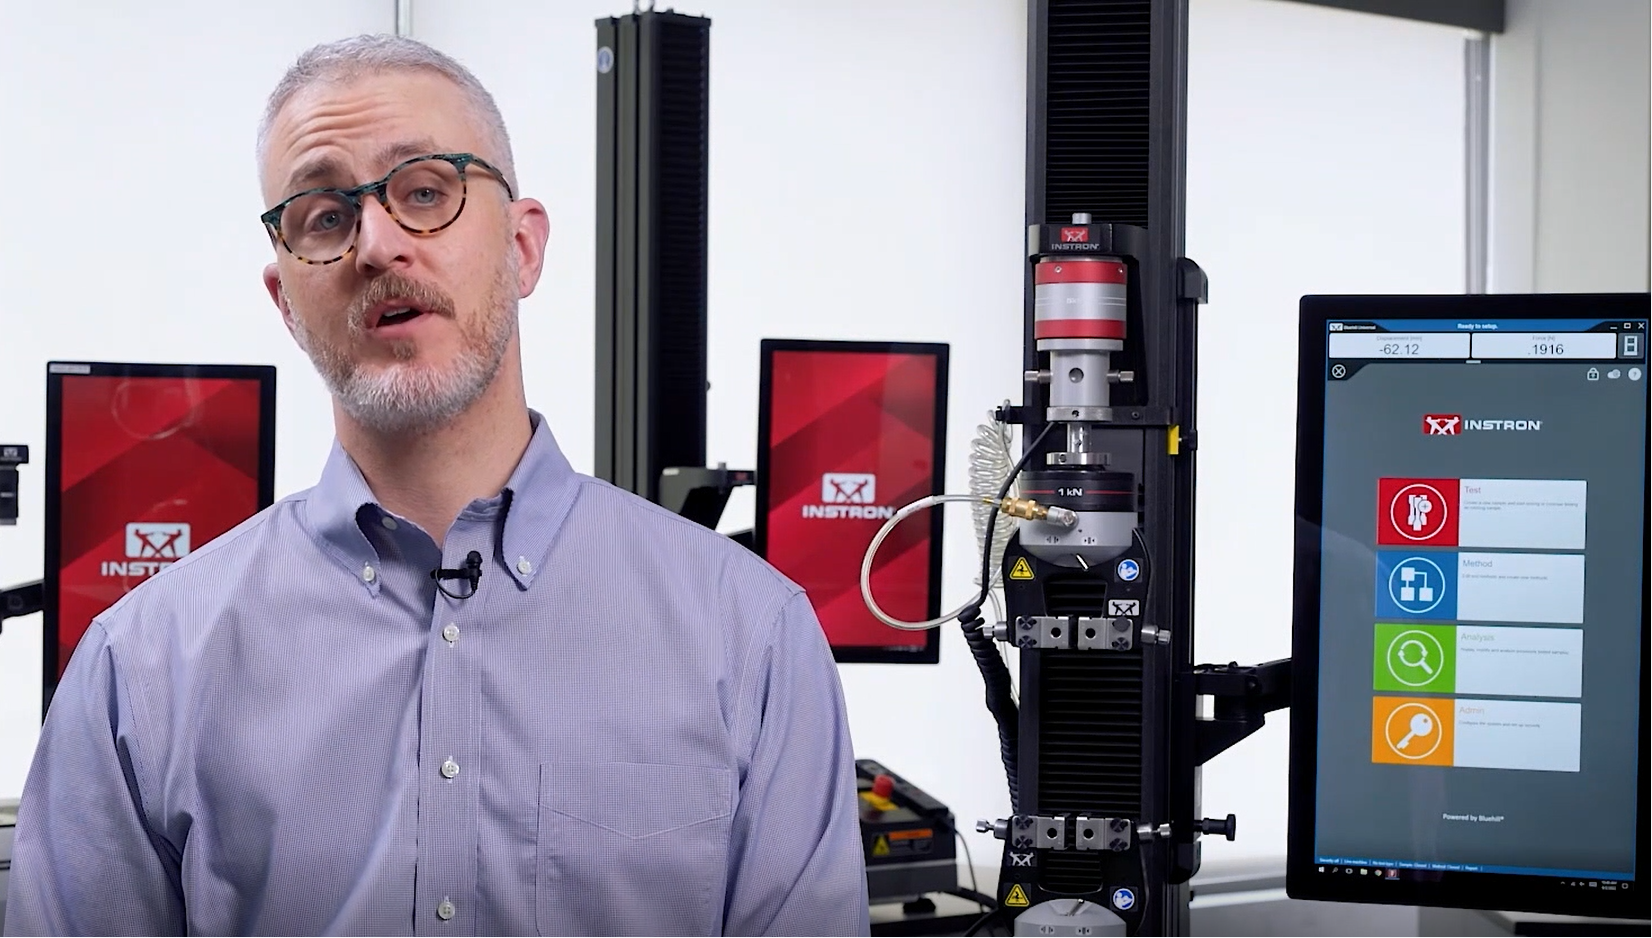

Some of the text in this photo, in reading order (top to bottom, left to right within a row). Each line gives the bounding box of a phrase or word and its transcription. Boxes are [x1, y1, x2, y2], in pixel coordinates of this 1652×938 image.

[1379, 343, 1419, 355] -62.12
[1527, 344, 1564, 355] .1916
[1464, 420, 1541, 431] INSTRON
[1058, 487, 1083, 496] 1 kN
[1464, 486, 1482, 494] Test
[802, 505, 894, 519] INSTRON
[1462, 559, 1493, 568] Method
[1460, 632, 1495, 642] Analysis
[1458, 705, 1485, 714] Admin
[1442, 813, 1469, 821] Powered
